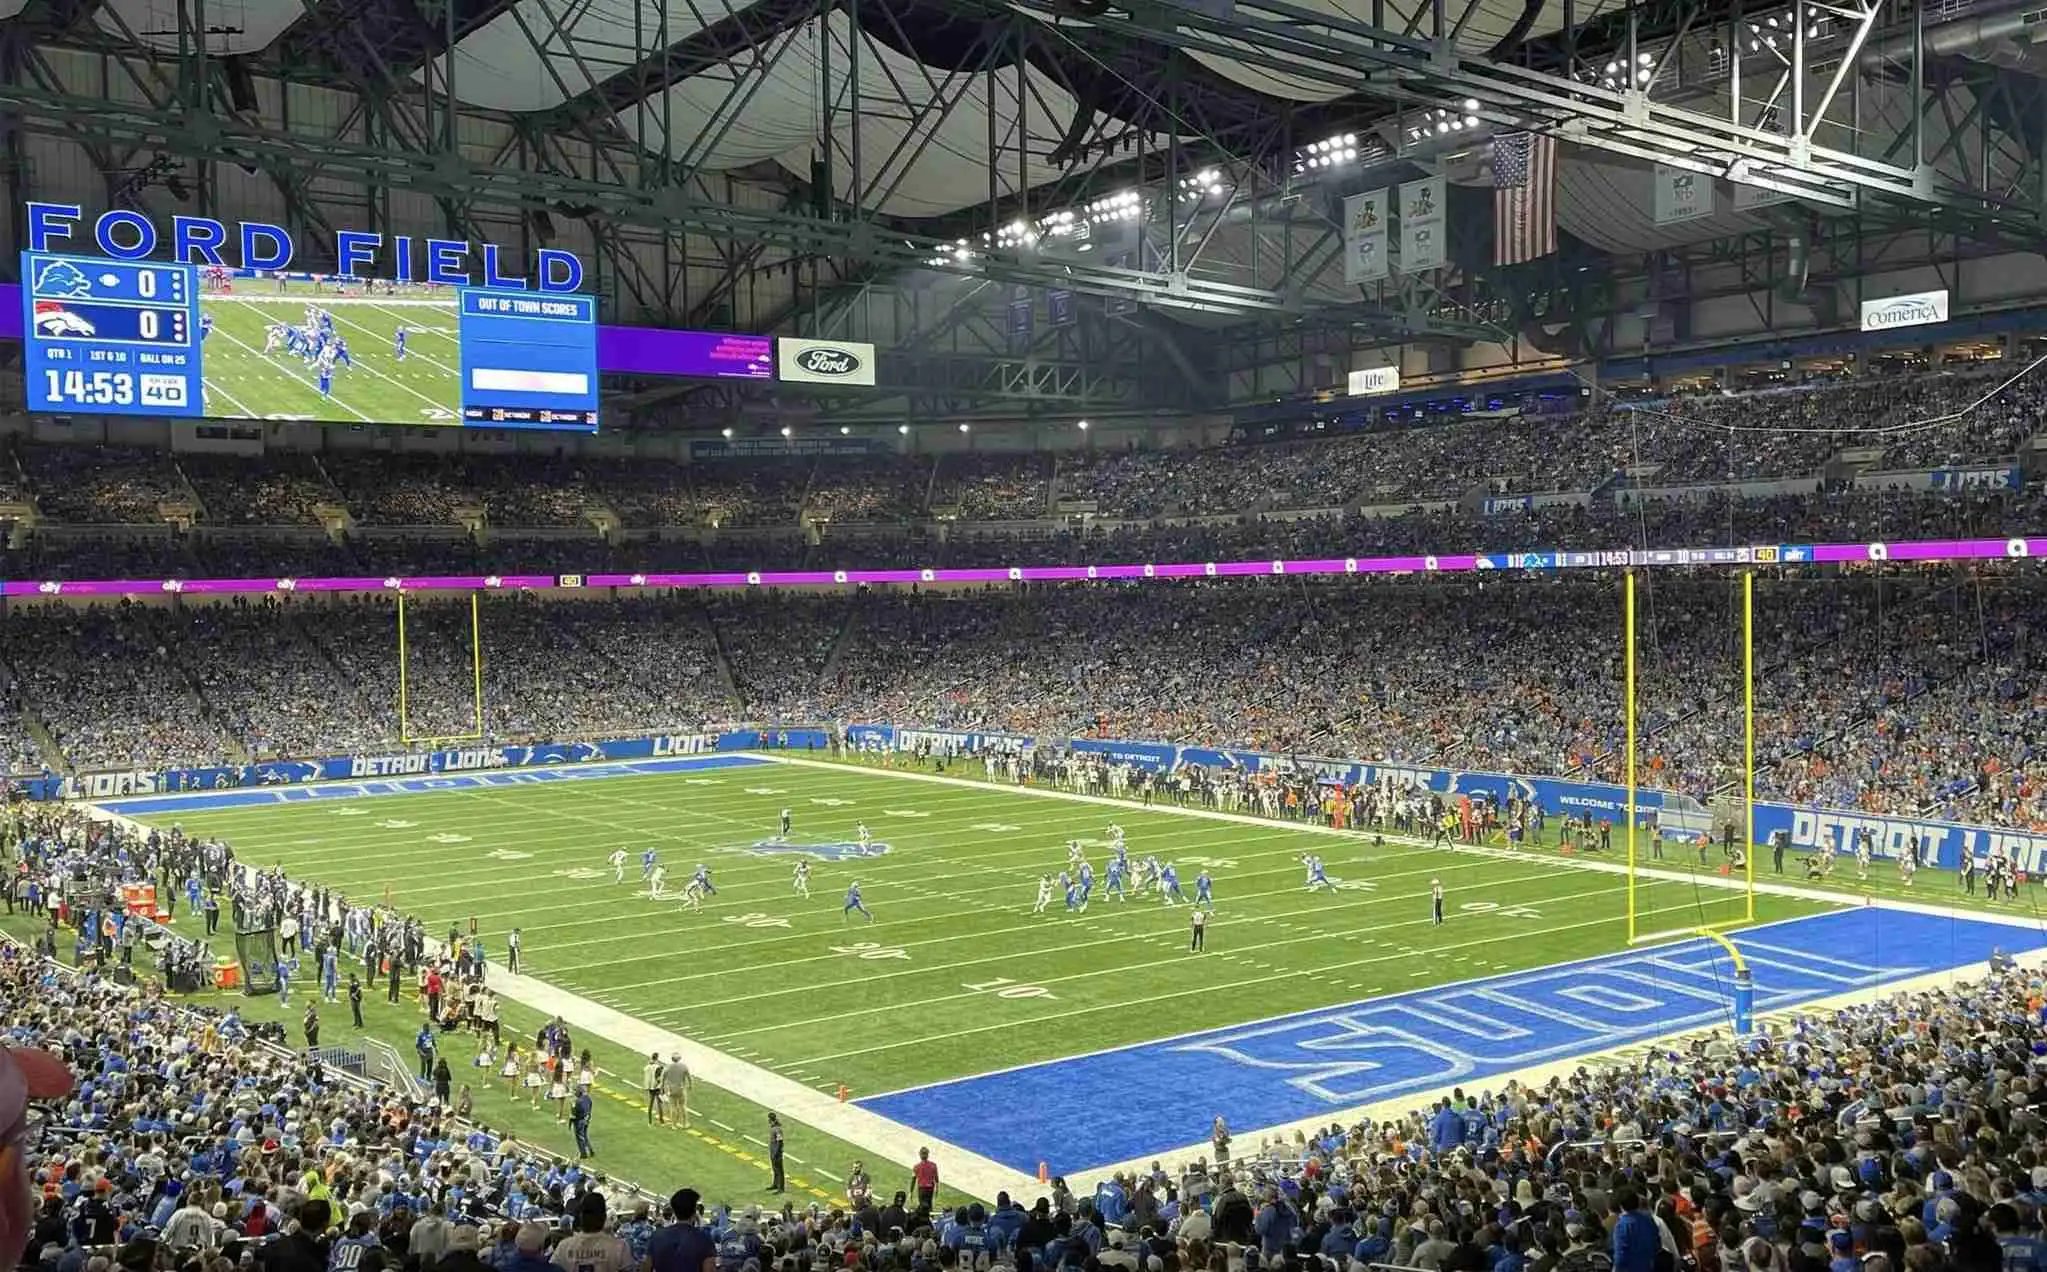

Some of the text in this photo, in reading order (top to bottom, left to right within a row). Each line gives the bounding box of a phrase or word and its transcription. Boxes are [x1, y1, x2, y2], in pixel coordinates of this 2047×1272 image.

[26, 202, 583, 293] FORD FIELD
[138, 269, 156, 297] 0
[478, 298, 577, 316] OUT OF TOWN SCORES
[140, 310, 158, 338] 0
[807, 350, 849, 373] Ford
[45, 369, 133, 404] 14:53
[1364, 373, 1384, 390] Lite
[146, 386, 182, 401] 40
[1757, 549, 1775, 560] 40
[1560, 795, 1616, 810] WELCOME
[1792, 810, 1948, 864] DETROIT
[961, 977, 1048, 998] 10
